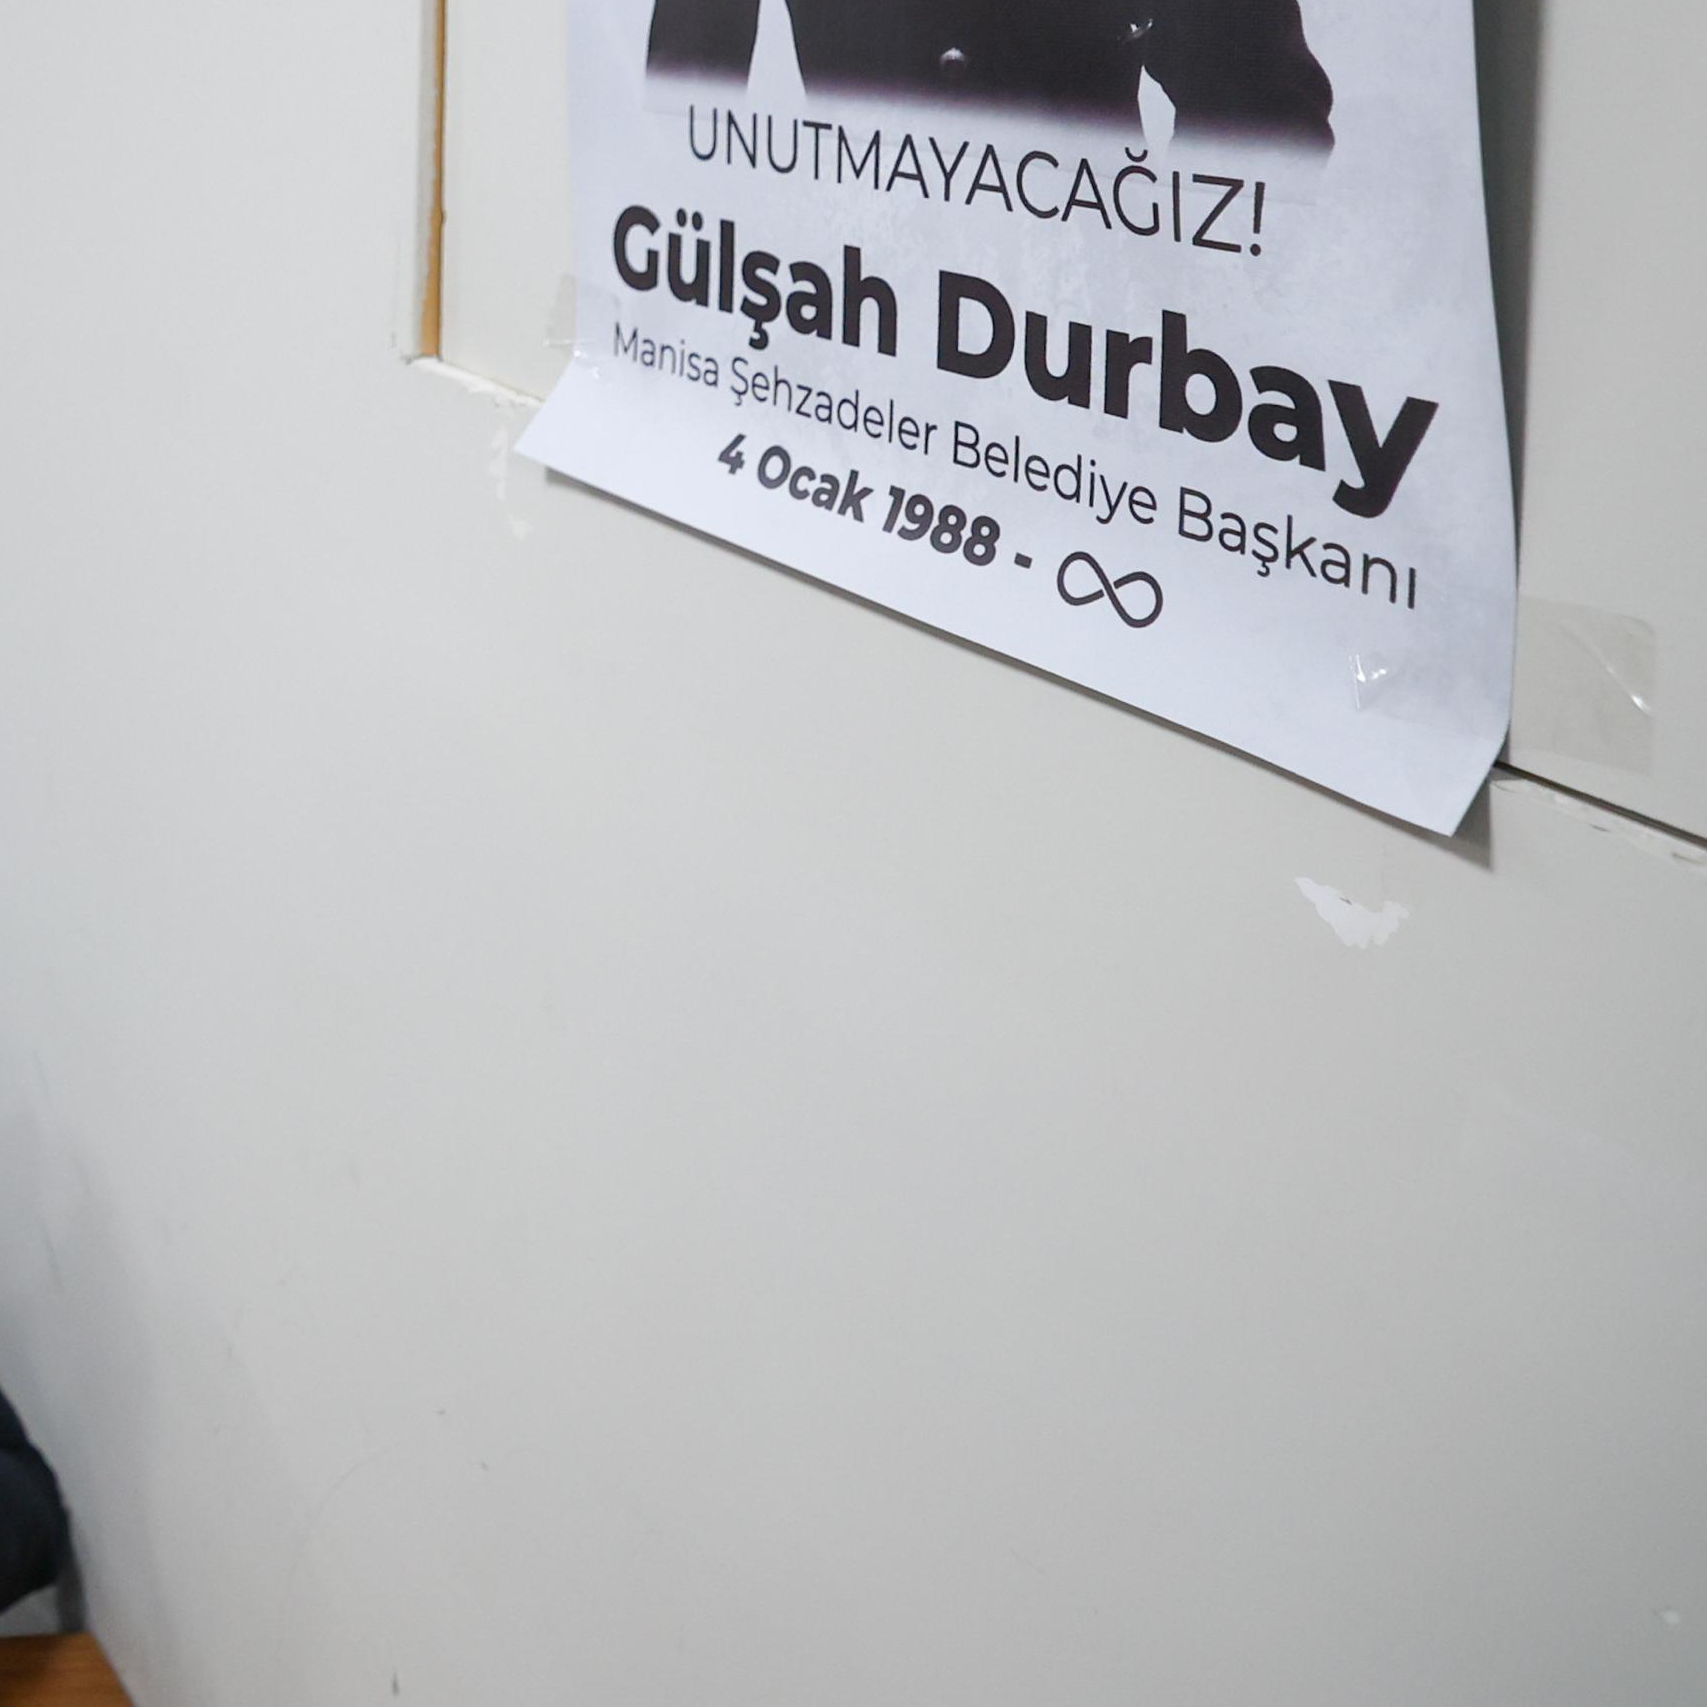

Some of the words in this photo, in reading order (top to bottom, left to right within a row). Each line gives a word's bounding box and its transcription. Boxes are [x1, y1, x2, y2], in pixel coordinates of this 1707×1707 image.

[688, 104, 1266, 257] UNUTMAYACAĞIZ!
[612, 205, 898, 358] Gülşah
[936, 269, 1440, 519] Durbay
[613, 321, 720, 388] Manisa
[730, 356, 939, 456] Şehzadeler
[952, 420, 1158, 526] Belediye
[1178, 486, 1418, 611] Başkanı
[717, 432, 747, 476] 4
[756, 444, 875, 524] Ocak
[881, 484, 1001, 568] 1988
